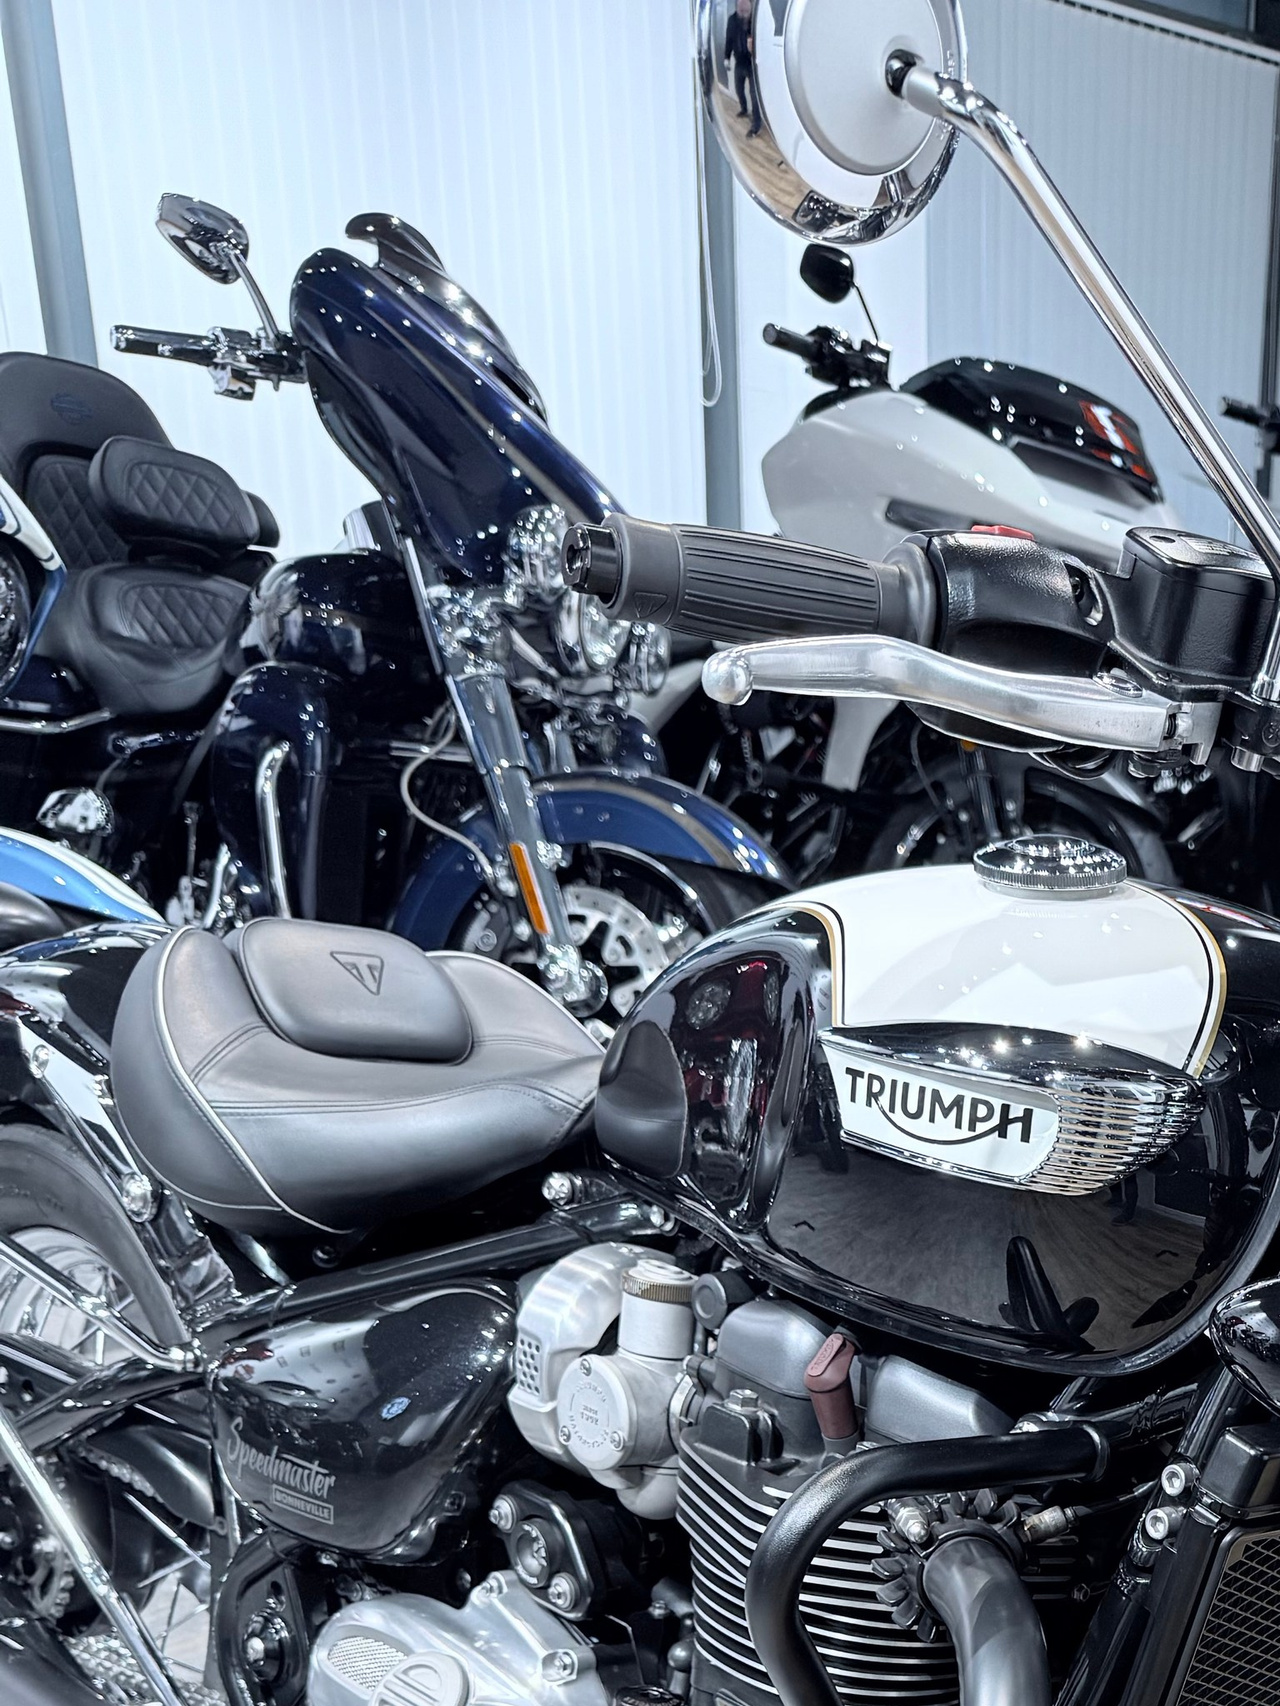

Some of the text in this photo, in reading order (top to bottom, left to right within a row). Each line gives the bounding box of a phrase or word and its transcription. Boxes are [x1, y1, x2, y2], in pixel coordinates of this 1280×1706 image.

[845, 1066, 1034, 1146] TRIUMPH
[227, 1416, 337, 1499] Speedmaster
[275, 1489, 331, 1519] BONNEVILLE
